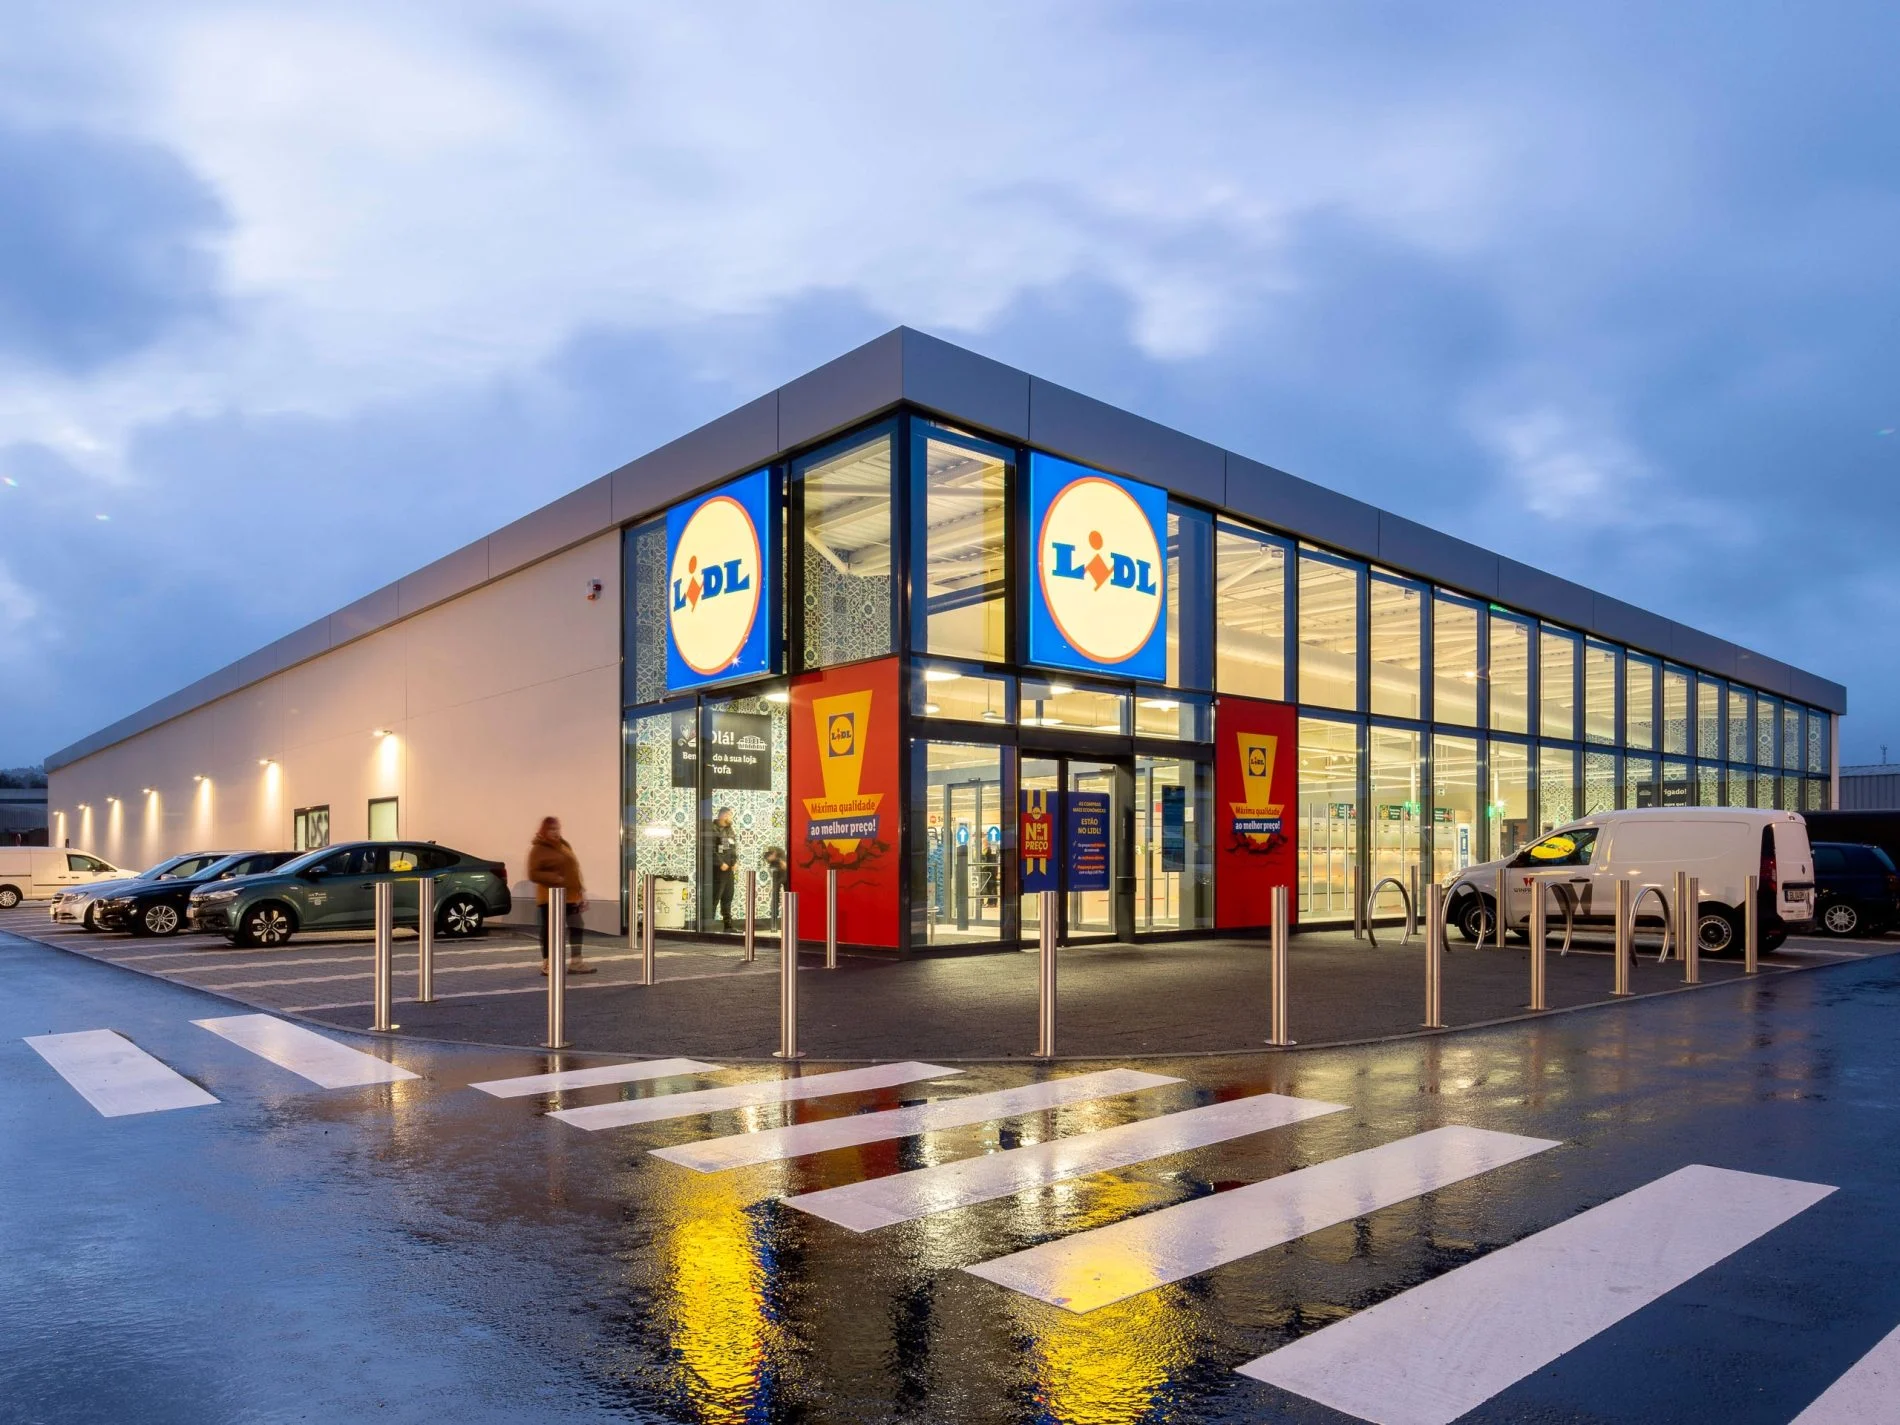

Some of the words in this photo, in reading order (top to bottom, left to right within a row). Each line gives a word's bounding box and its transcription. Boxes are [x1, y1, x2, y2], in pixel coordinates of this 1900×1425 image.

[743, 755, 757, 765] loja
[811, 801, 838, 814] Máxima
[839, 799, 876, 815] qualidade
[1236, 806, 1255, 815] Máxima
[1256, 807, 1280, 817] qualidade
[1081, 817, 1098, 826] ESTÃO
[1244, 820, 1263, 830] melhor
[1263, 820, 1280, 832] preço!
[811, 825, 820, 836] ao
[821, 820, 849, 835] melhor
[850, 818, 876, 837] preço!
[1025, 841, 1048, 852] PREÇO
